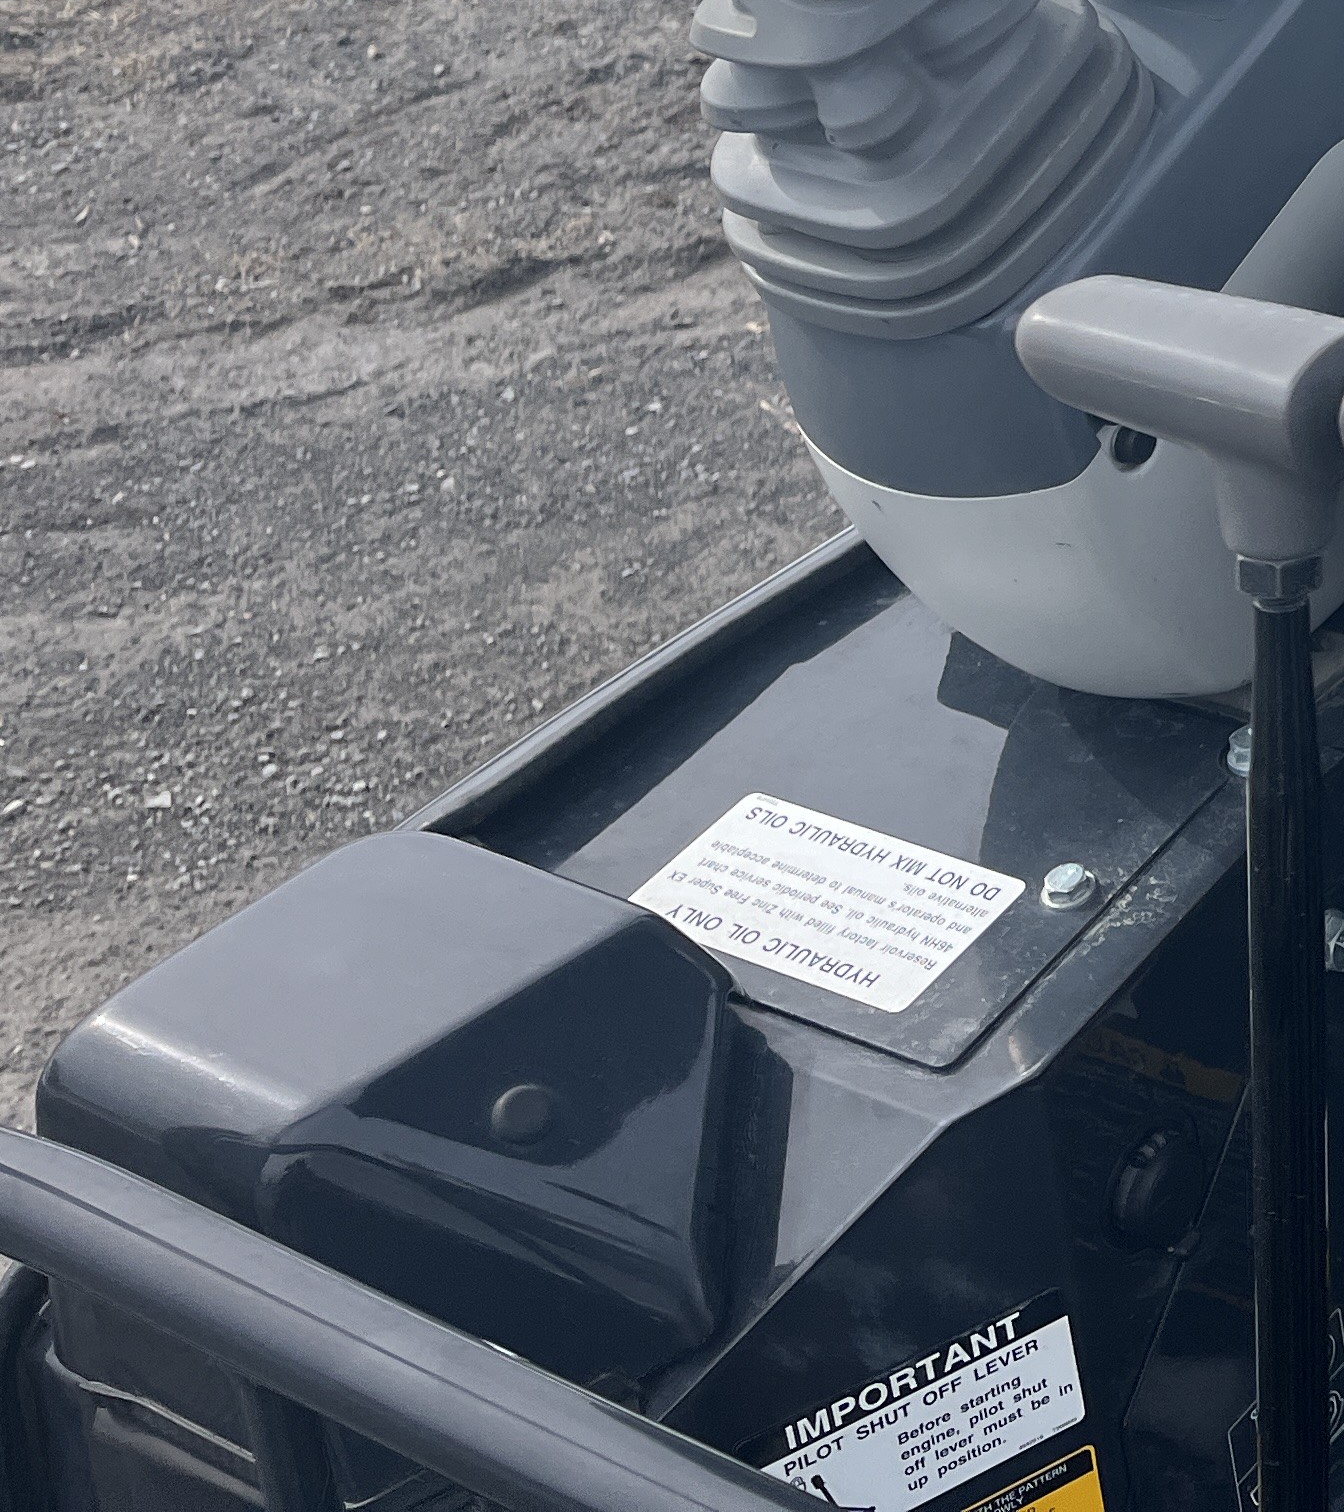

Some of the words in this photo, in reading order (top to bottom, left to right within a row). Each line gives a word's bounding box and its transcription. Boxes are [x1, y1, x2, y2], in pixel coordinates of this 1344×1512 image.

[745, 807, 789, 828] OILS
[710, 840, 771, 865] acceptable
[788, 821, 892, 864] HYDRAULIC
[666, 869, 688, 882] EX
[696, 857, 729, 873] chart
[771, 860, 827, 886] determine
[889, 854, 928, 876] MIX
[687, 877, 723, 895] Super
[729, 868, 772, 888] service
[828, 880, 843, 892] to
[924, 867, 970, 890] NOT
[723, 888, 751, 905] Free
[771, 883, 822, 904] periodic
[840, 885, 887, 905] manual
[969, 882, 1002, 901] DO
[778, 907, 805, 922] with
[819, 899, 844, 915] See
[927, 892, 989, 918] alternative
[666, 904, 723, 931] ONLY
[803, 917, 837, 935] filled
[865, 915, 921, 942] hydraulic
[945, 921, 973, 935] and
[728, 923, 761, 944] OIL
[836, 927, 880, 950] factory
[762, 937, 881, 988] HYDRAULIC
[879, 943, 938, 971] Reservoir
[784, 1309, 1020, 1450] IMPORTANT
[783, 1435, 844, 1478] PILOT
[855, 1401, 911, 1440] SHUT
[922, 1375, 962, 1406] OFF
[973, 1339, 1039, 1382] LEVER
[897, 1412, 951, 1446] Before
[960, 1376, 1021, 1413] starting
[900, 1427, 960, 1461] engine,
[969, 1400, 1005, 1429] pilot
[1013, 1378, 1048, 1403] shut
[904, 1456, 926, 1476] off
[934, 1433, 974, 1461] lever
[983, 1407, 1023, 1436] must
[1030, 1395, 1050, 1411] be
[1058, 1383, 1073, 1397] in
[907, 1475, 929, 1491] up
[937, 1437, 1007, 1479] position.
[994, 1492, 1016, 1507] THE
[1018, 1463, 1067, 1496] PATTERN
